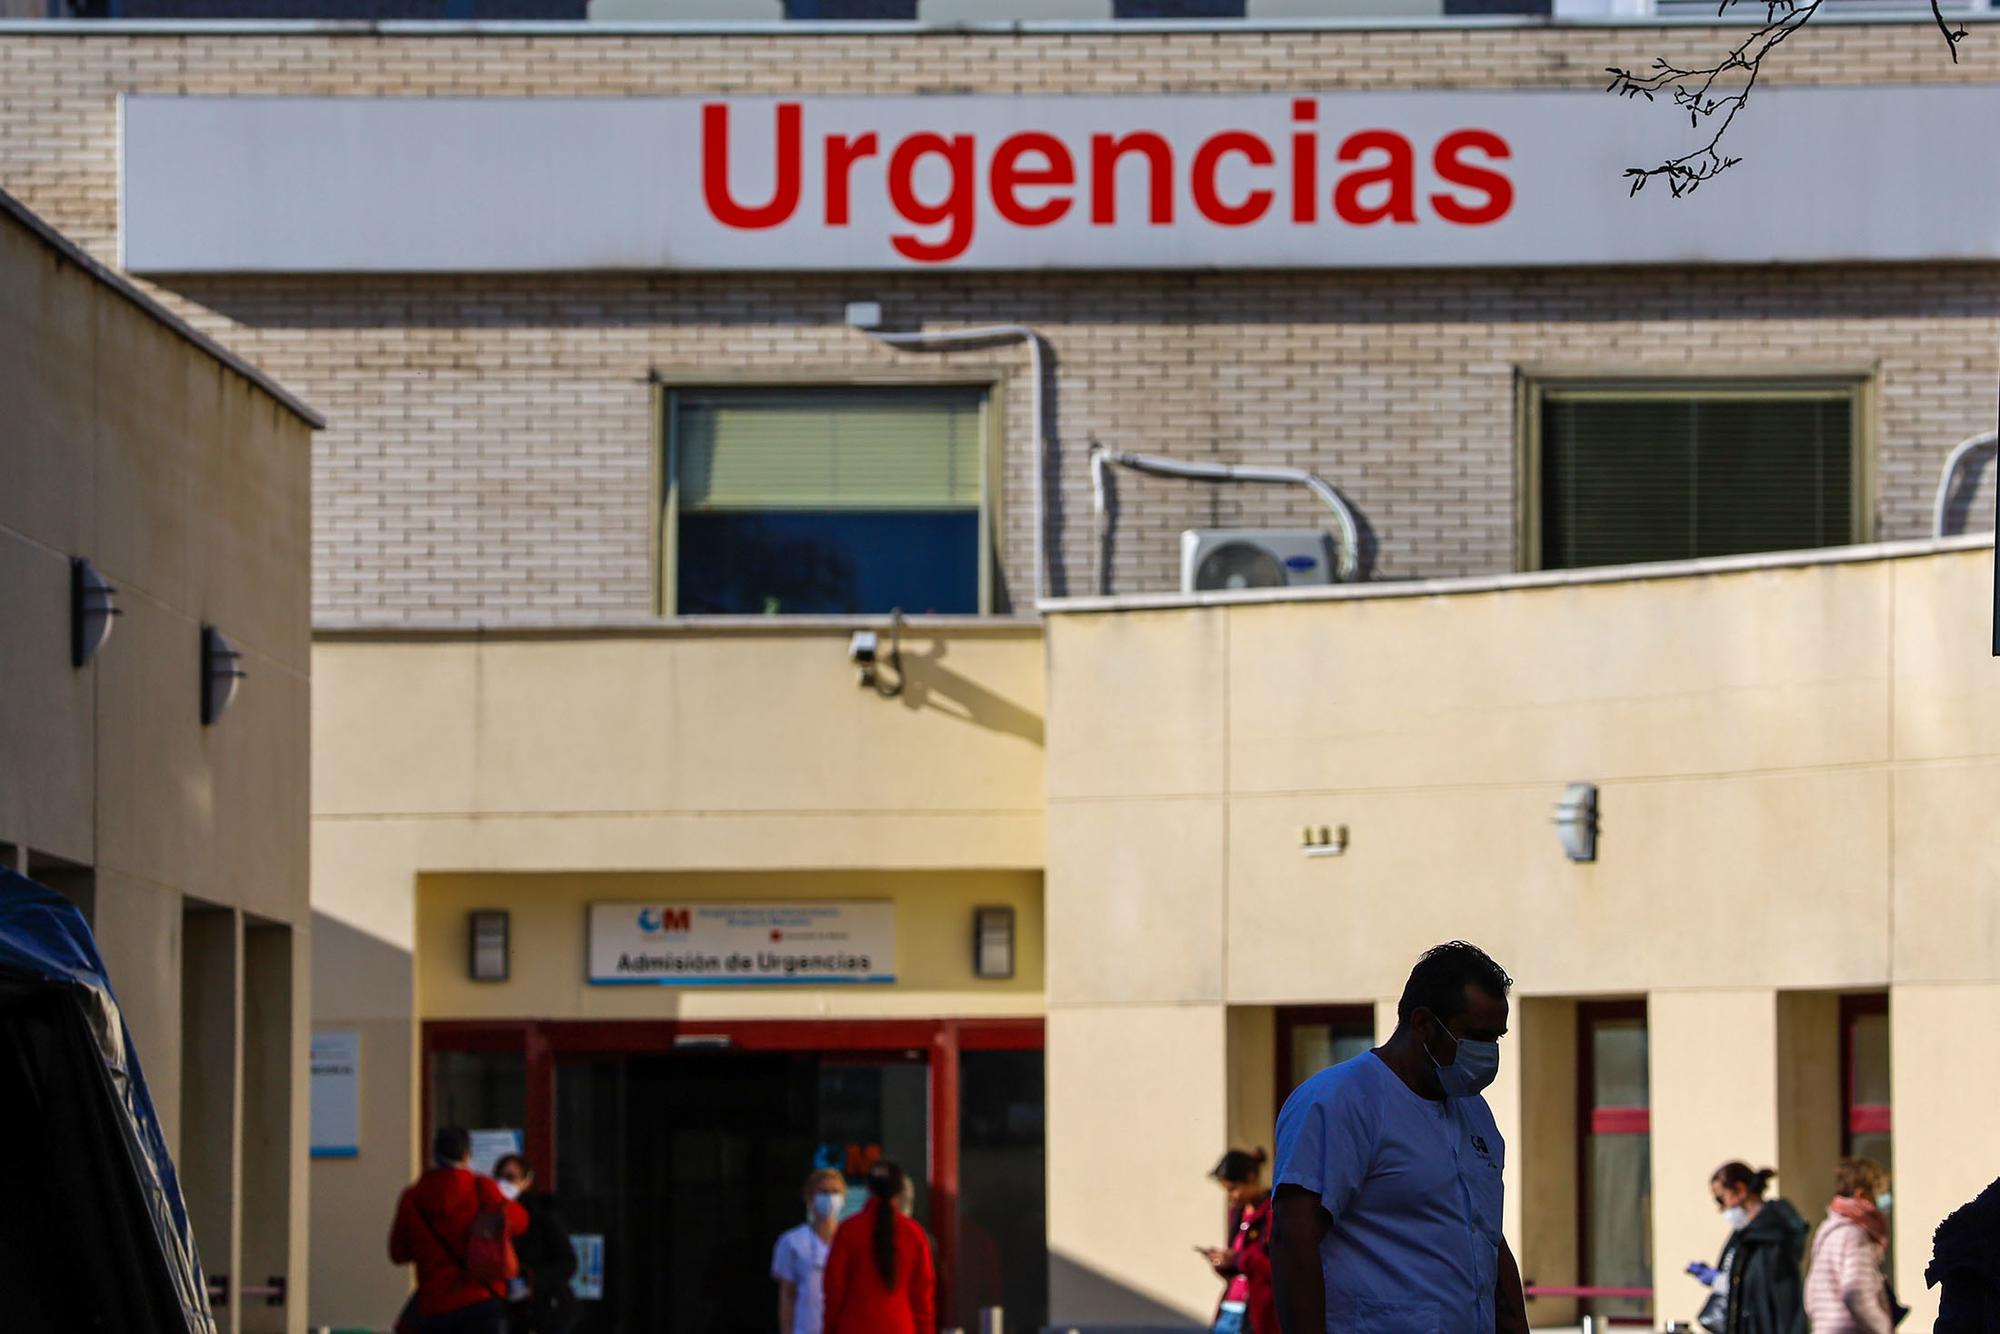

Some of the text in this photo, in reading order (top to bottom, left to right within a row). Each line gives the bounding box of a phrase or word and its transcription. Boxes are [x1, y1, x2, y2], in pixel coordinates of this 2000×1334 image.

[702, 99, 1515, 263] Urgencias
[617, 951, 871, 977] Admisión de Urgencias
